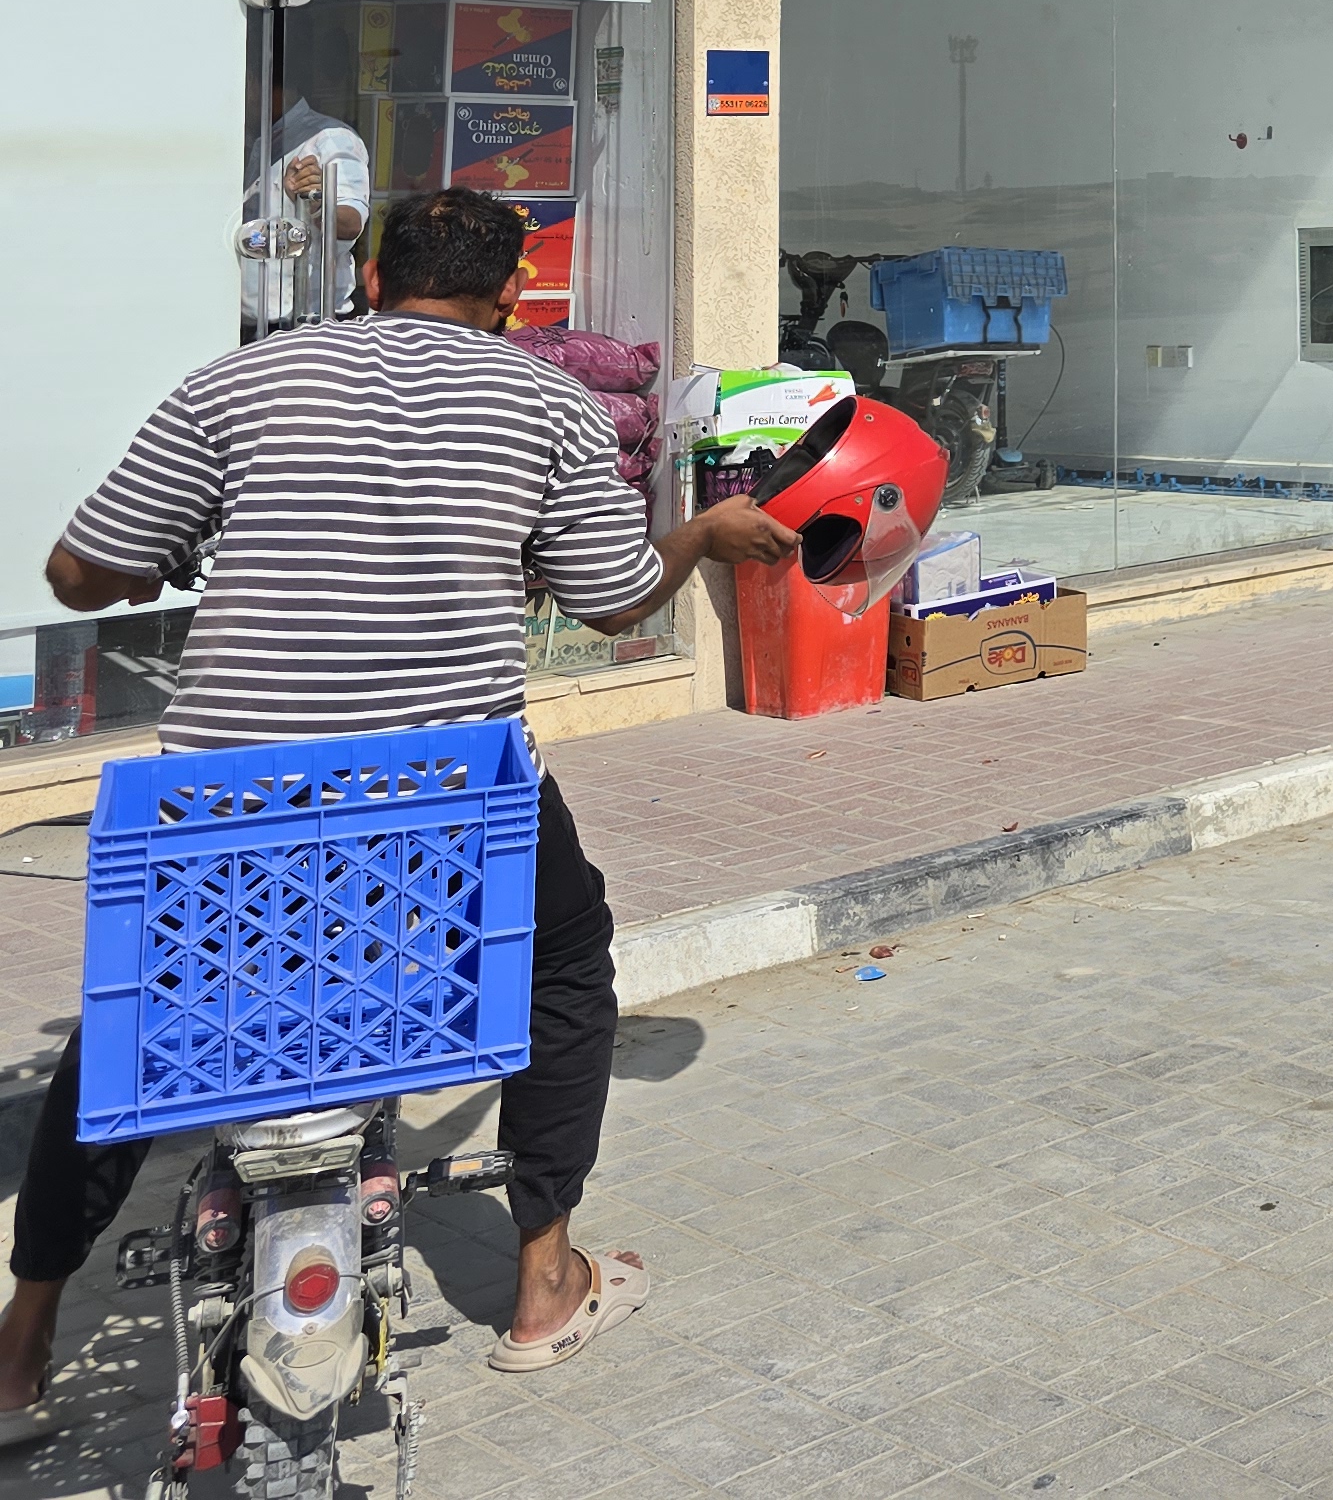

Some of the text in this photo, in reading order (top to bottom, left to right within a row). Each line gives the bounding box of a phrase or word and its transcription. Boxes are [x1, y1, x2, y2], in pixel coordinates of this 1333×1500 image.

[513, 53, 552, 67] Oman
[519, 64, 557, 79] Chips
[467, 119, 506, 134] Chips
[471, 132, 512, 144] Oman
[748, 413, 809, 426] Fresh Carrot
[986, 613, 1029, 631] BANANAS
[987, 645, 1027, 668] Dole
[551, 1329, 581, 1354] SMILE
